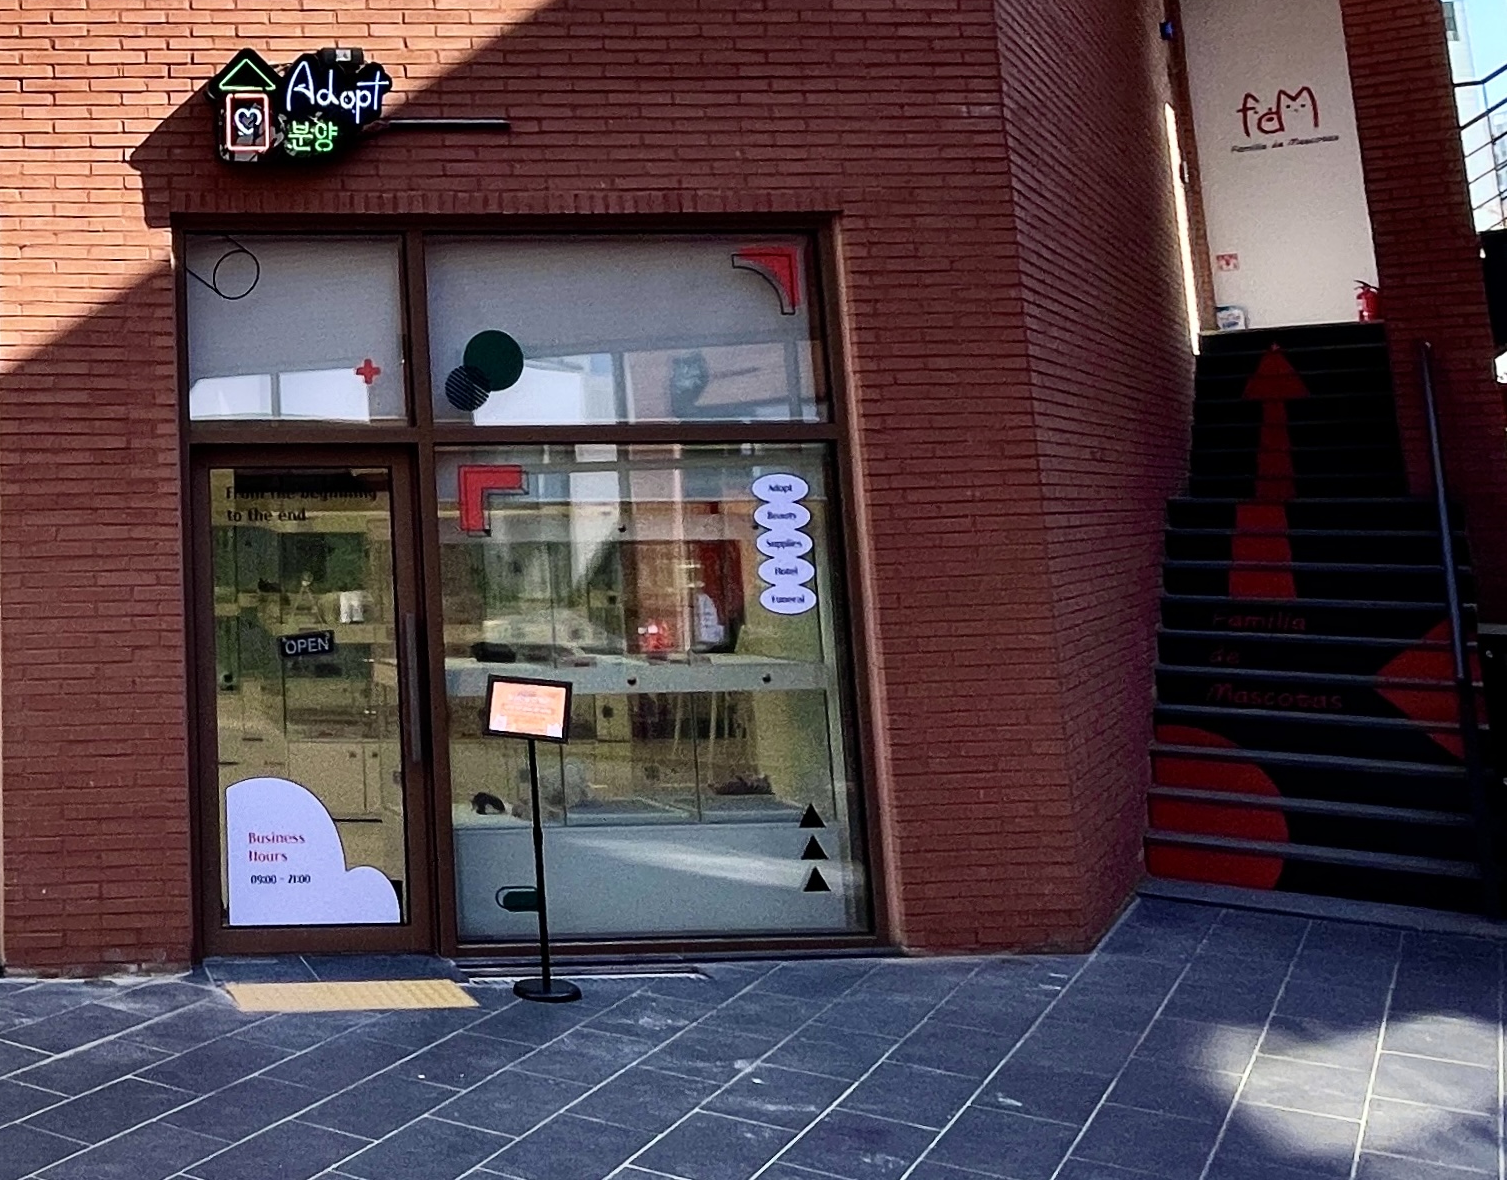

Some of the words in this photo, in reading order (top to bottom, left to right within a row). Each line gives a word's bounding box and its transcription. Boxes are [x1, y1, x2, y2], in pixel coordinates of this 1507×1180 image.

[286, 61, 390, 124] Adopt
[287, 120, 338, 152] 분양
[768, 484, 793, 494] Adopt
[227, 509, 241, 522] to
[248, 507, 271, 522] the
[278, 507, 306, 522] end
[284, 637, 330, 656] OPEN
[248, 831, 306, 844] Business
[248, 850, 288, 862] Hours
[250, 874, 277, 884] 09:00
